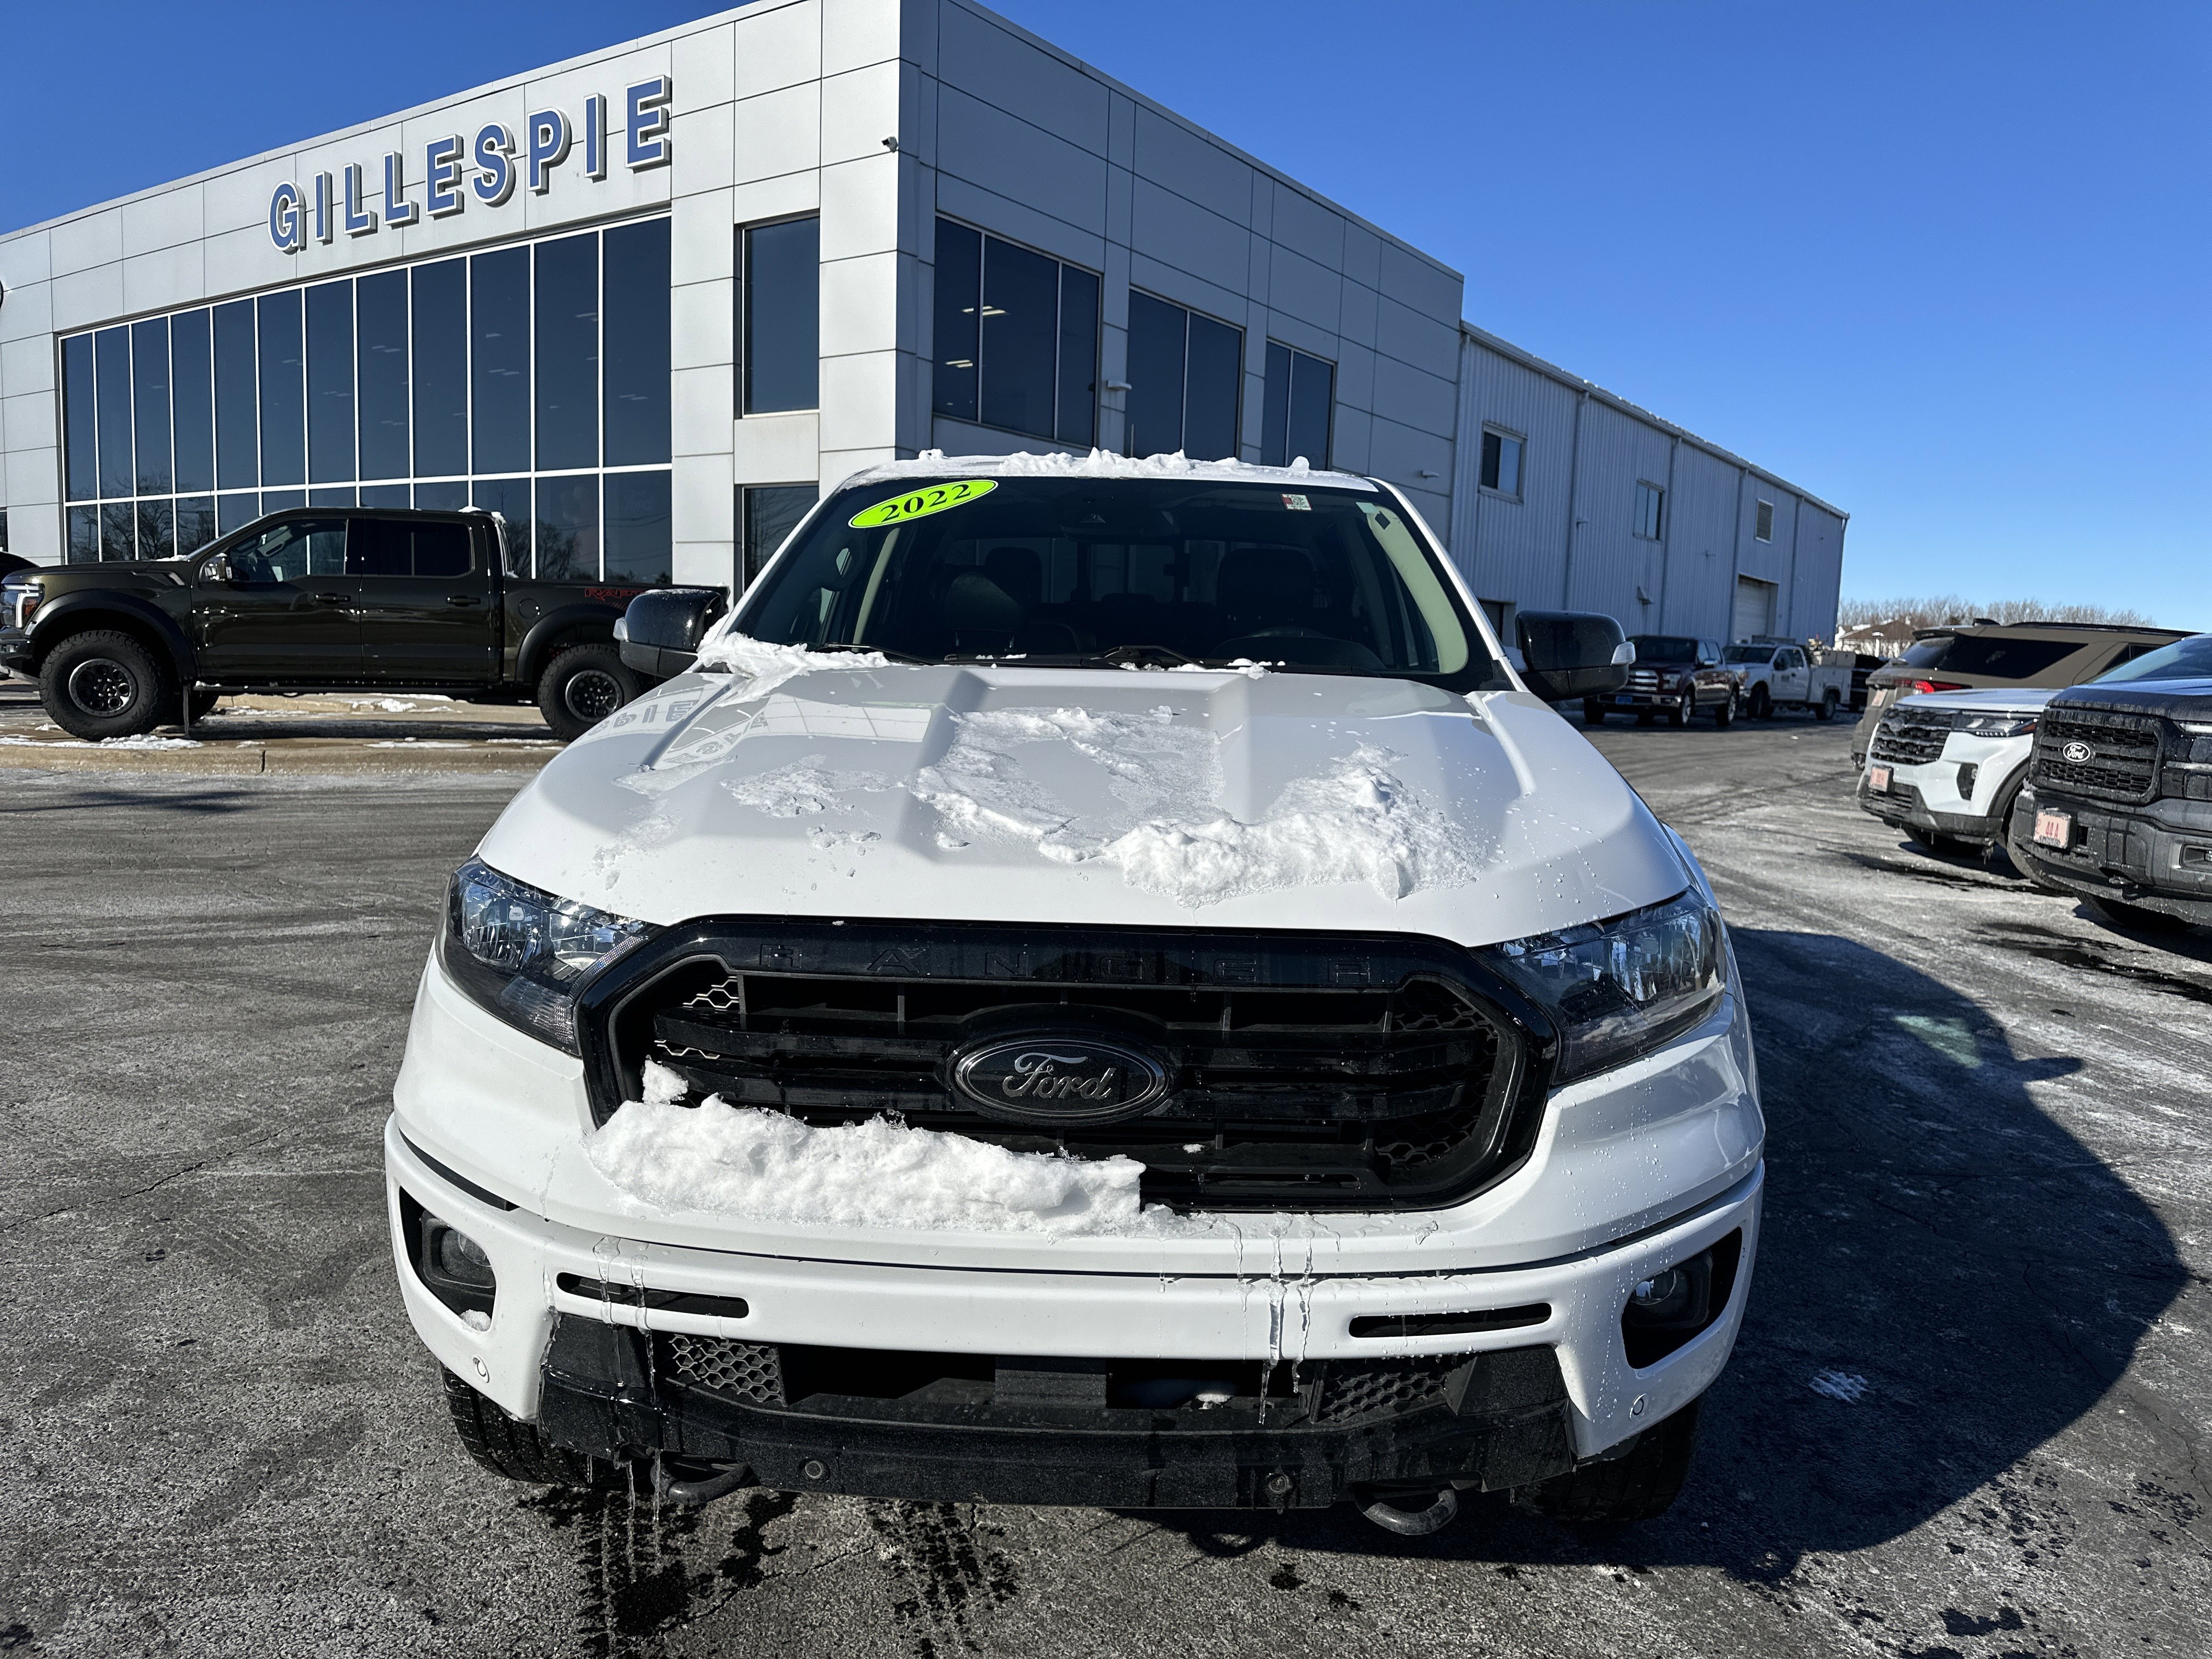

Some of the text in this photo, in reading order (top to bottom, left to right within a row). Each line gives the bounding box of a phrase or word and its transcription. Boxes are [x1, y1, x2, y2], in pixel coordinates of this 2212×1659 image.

[268, 74, 673, 254] GILLESPIE
[879, 483, 972, 523] 2022
[2067, 744, 2085, 759] Ford
[759, 941, 1371, 984] RANGER
[1002, 1052, 1117, 1101] Ford
